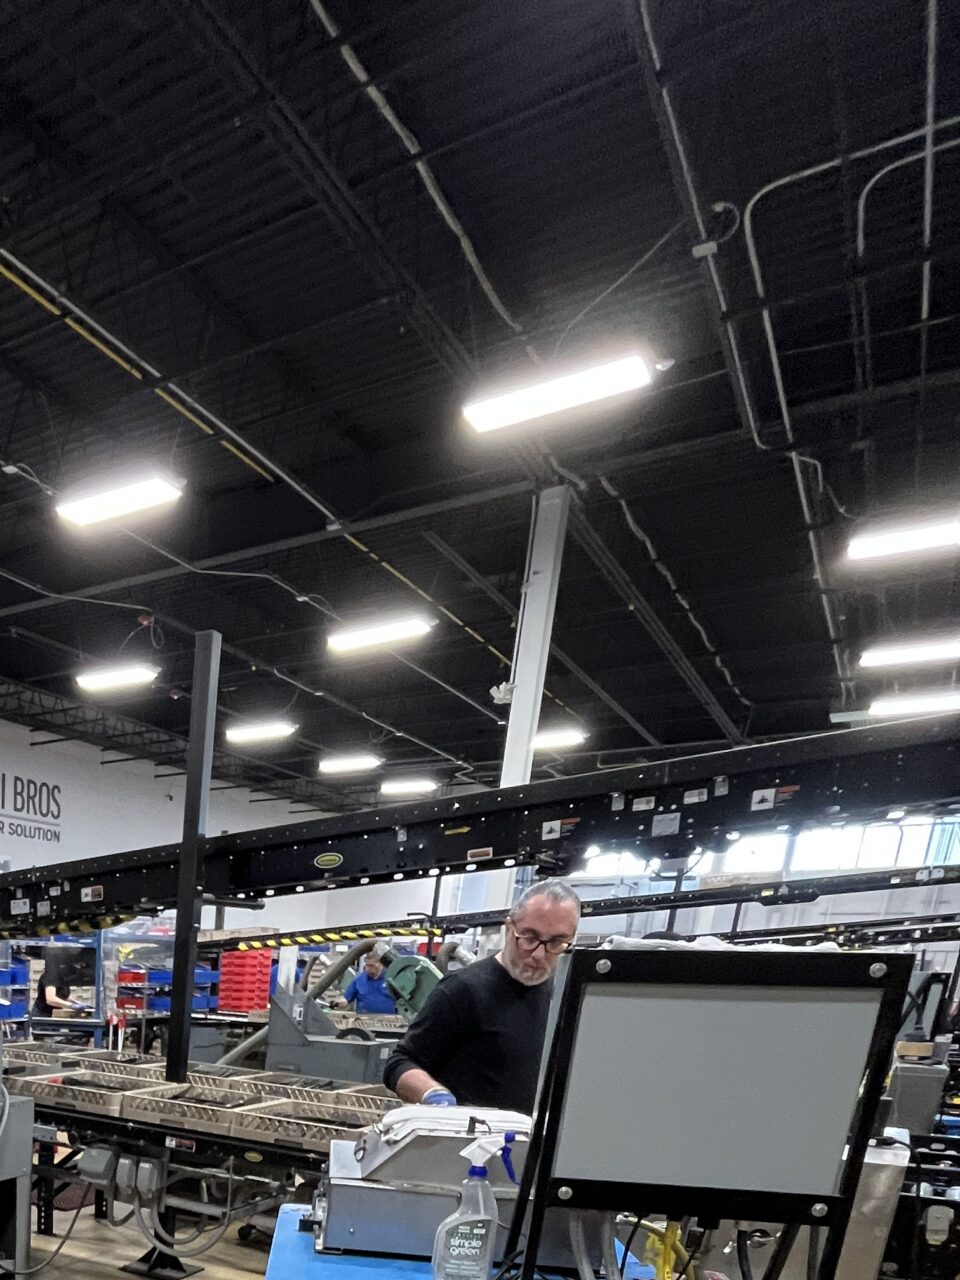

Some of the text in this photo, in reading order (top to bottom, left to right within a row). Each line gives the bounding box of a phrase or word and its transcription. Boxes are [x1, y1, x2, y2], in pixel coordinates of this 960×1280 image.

[13, 775, 62, 820] BROS
[8, 822, 61, 844] SOLUTION
[449, 1236, 483, 1249] simple
[449, 1246, 480, 1257] green
